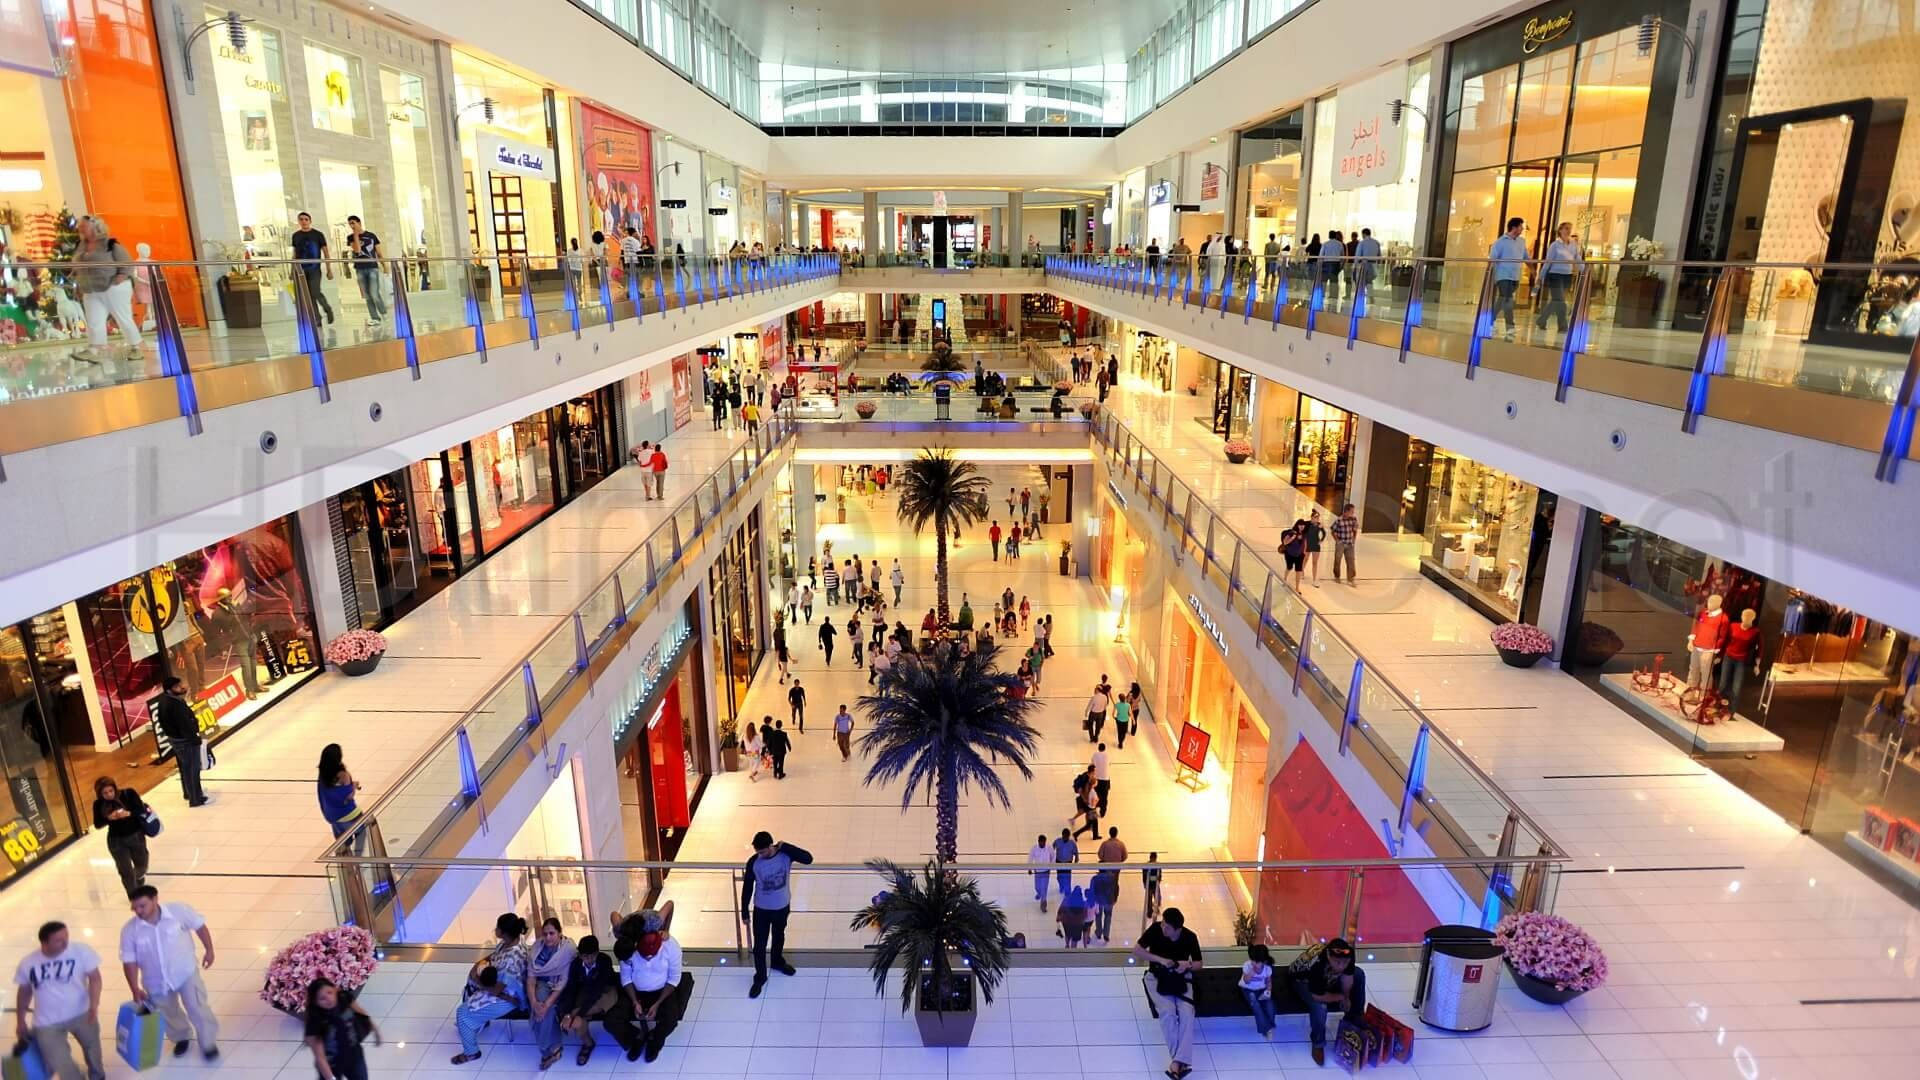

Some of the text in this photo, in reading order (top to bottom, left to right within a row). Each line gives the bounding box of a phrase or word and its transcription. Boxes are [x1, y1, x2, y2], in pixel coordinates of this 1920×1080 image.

[1523, 9, 1573, 54] Bonpoint
[1351, 116, 1379, 150] انجلز
[1341, 145, 1385, 178] angels
[287, 647, 310, 666] 45
[208, 684, 239, 712] SOLD
[19, 777, 47, 841] Guy Laroche
[3, 828, 39, 862] 80
